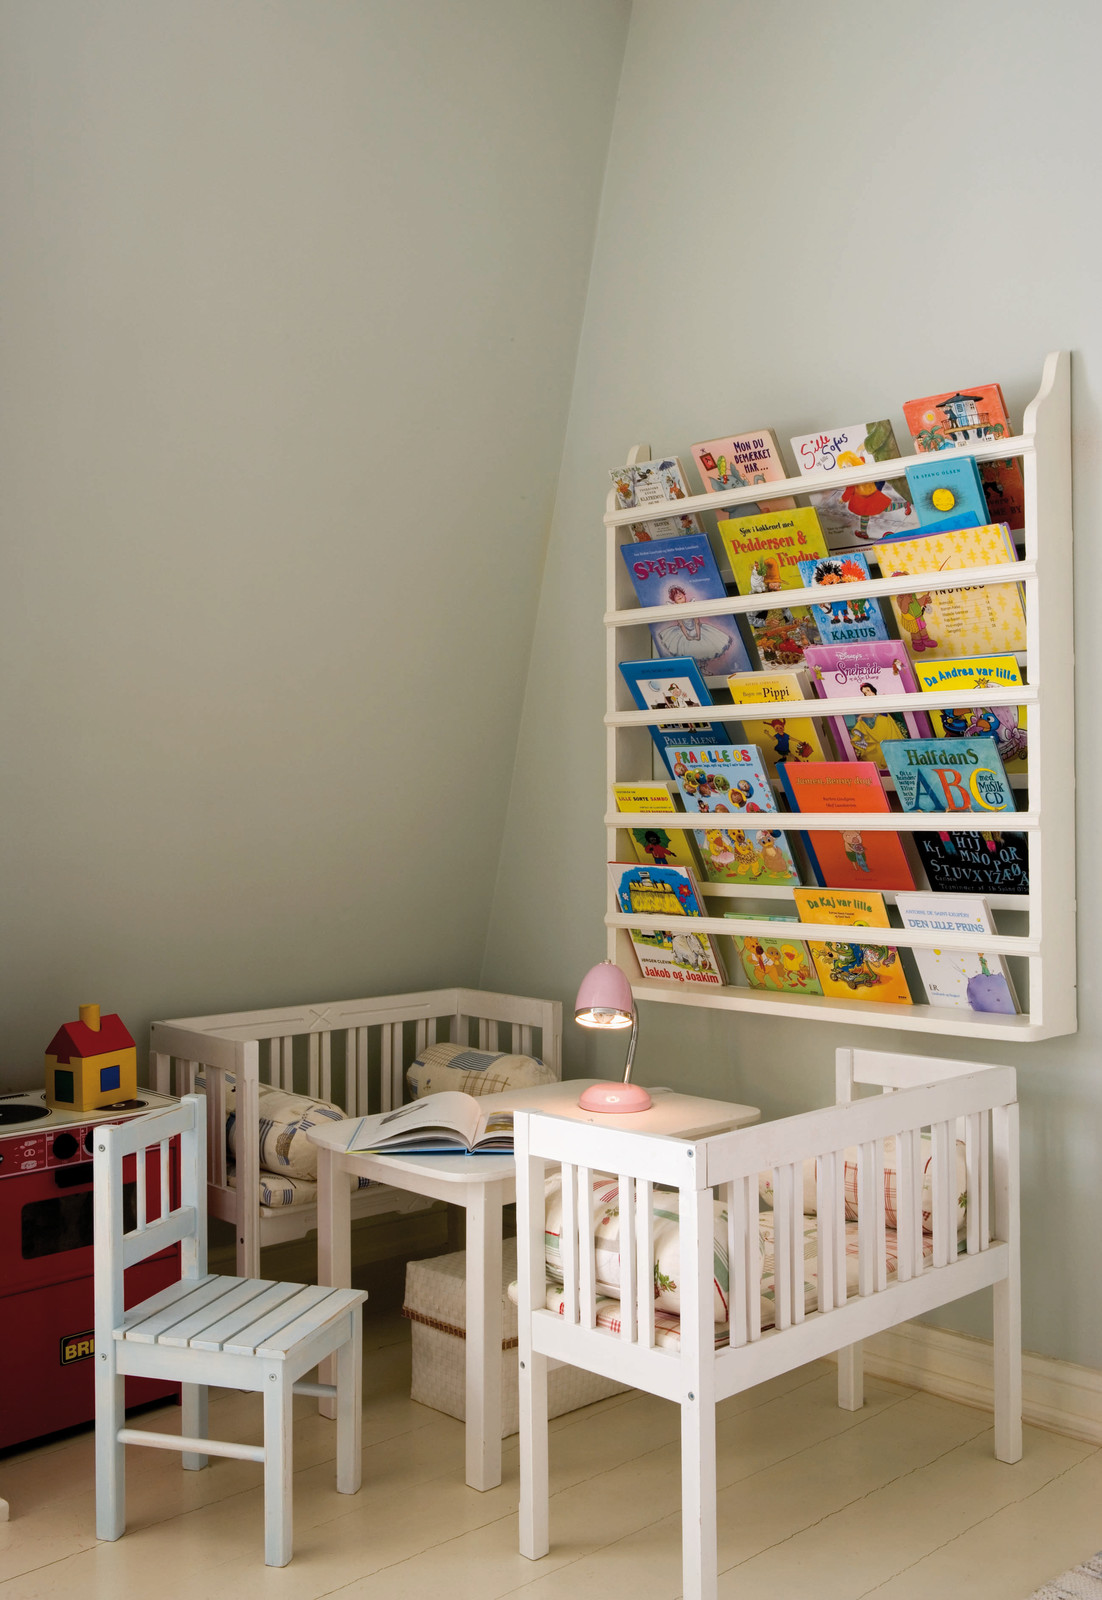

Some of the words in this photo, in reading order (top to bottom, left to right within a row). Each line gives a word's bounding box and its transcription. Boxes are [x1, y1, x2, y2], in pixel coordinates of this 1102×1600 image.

[752, 438, 764, 449] DU
[734, 449, 771, 464] BEMÆRKET
[730, 535, 795, 554] Peddersen
[797, 530, 807, 545] &
[776, 551, 820, 567] Findus
[831, 627, 876, 640] KARIUS
[924, 676, 938, 687] Da
[938, 668, 974, 681] Andrea
[976, 668, 994, 676] var
[996, 668, 1017, 682] lille
[762, 686, 789, 699] Pippi
[675, 751, 698, 763] FRA
[701, 750, 731, 762] ALLE
[734, 750, 751, 762] OS
[909, 767, 1008, 811] ABC
[985, 793, 1003, 804] CD
[807, 900, 819, 909] Da
[819, 897, 835, 908] Kaj
[854, 900, 872, 912] lille
[908, 919, 929, 928] DEN
[930, 920, 955, 930] LILLE
[955, 922, 985, 933] PRINS
[645, 966, 671, 978] Jakob
[672, 971, 685, 982] og
[686, 972, 719, 983] Joakim
[65, 1340, 94, 1360] BRI
